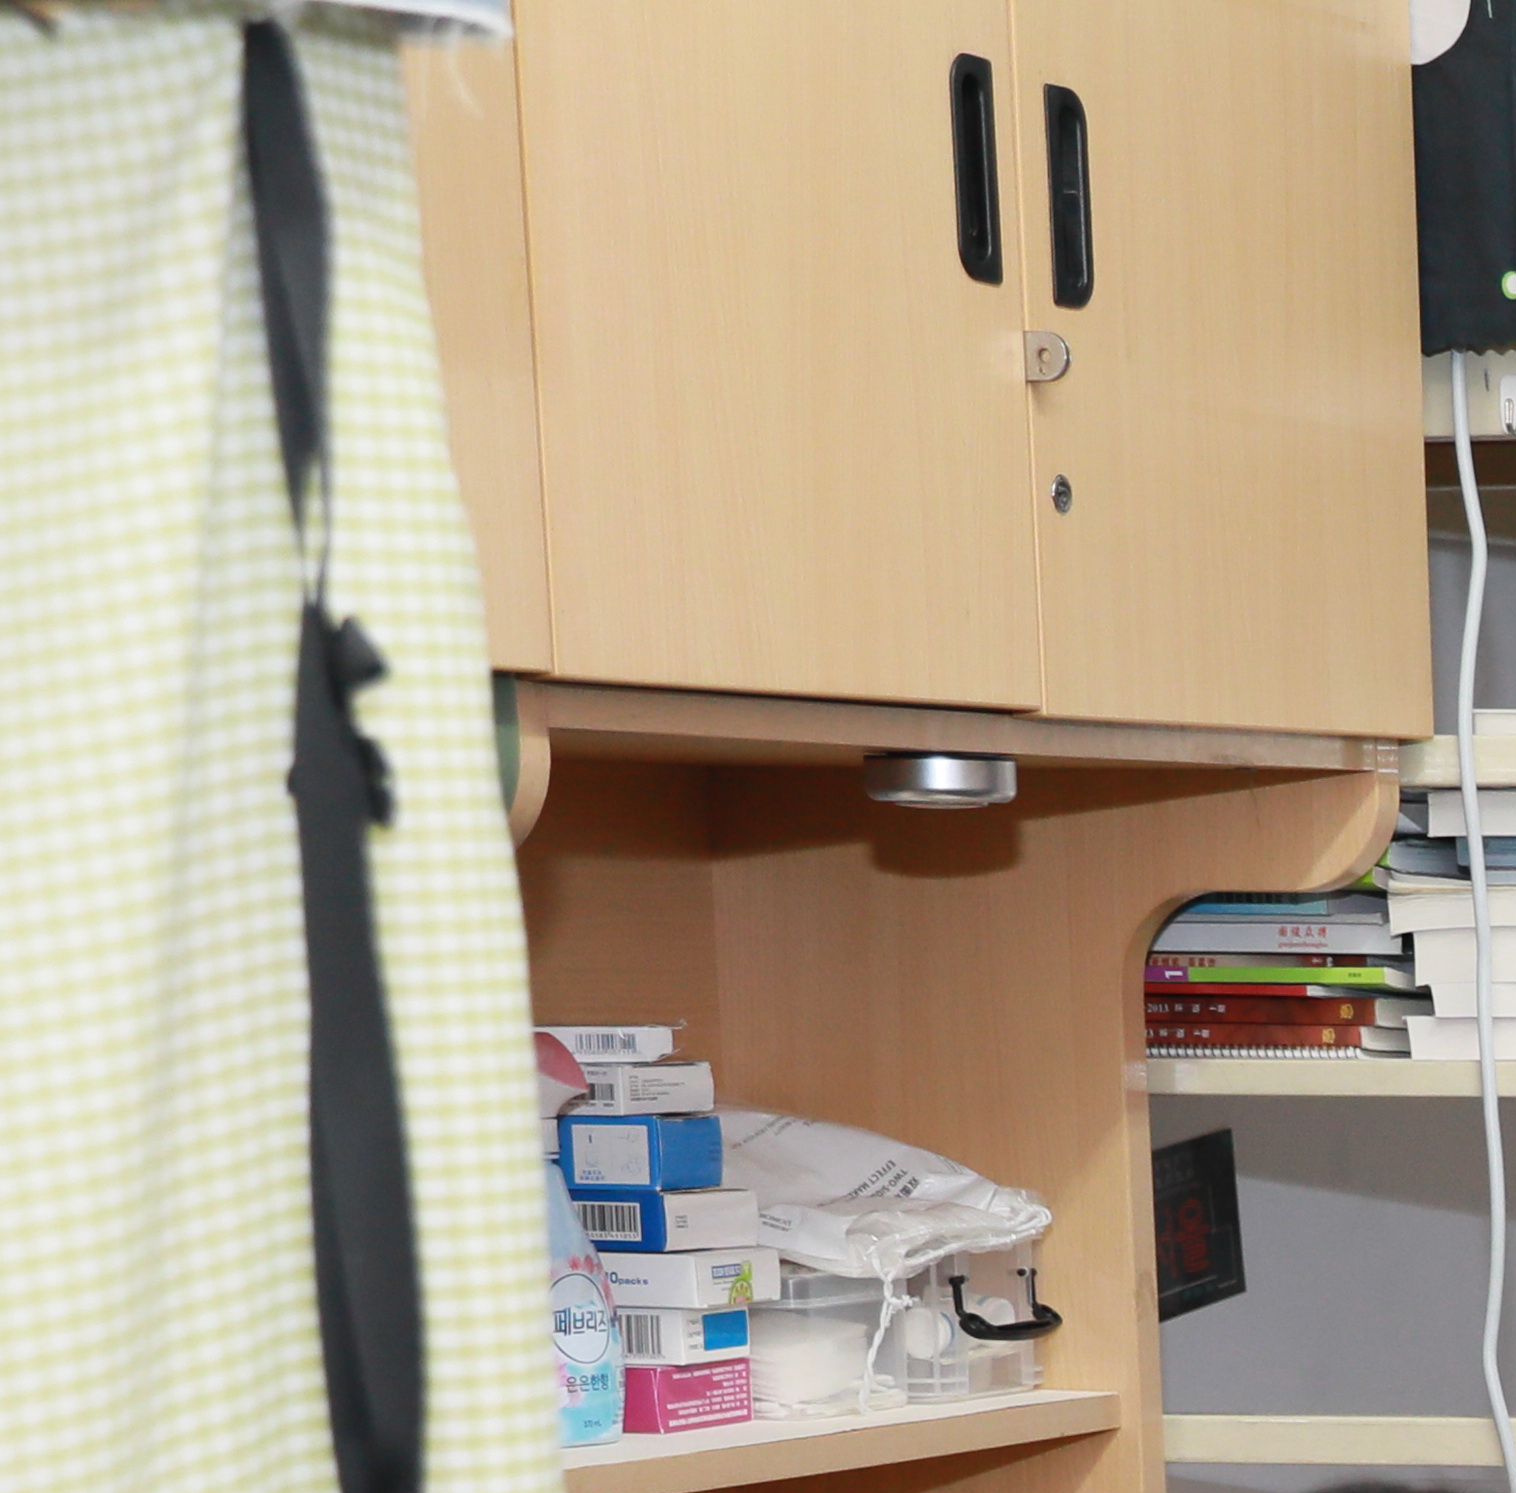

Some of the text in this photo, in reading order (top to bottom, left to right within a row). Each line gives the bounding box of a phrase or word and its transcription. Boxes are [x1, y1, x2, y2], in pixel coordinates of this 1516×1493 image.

[605, 1271, 649, 1285] 0packs
[553, 1310, 608, 1336] 페브리즈
[565, 1374, 609, 1393] 은은한향
